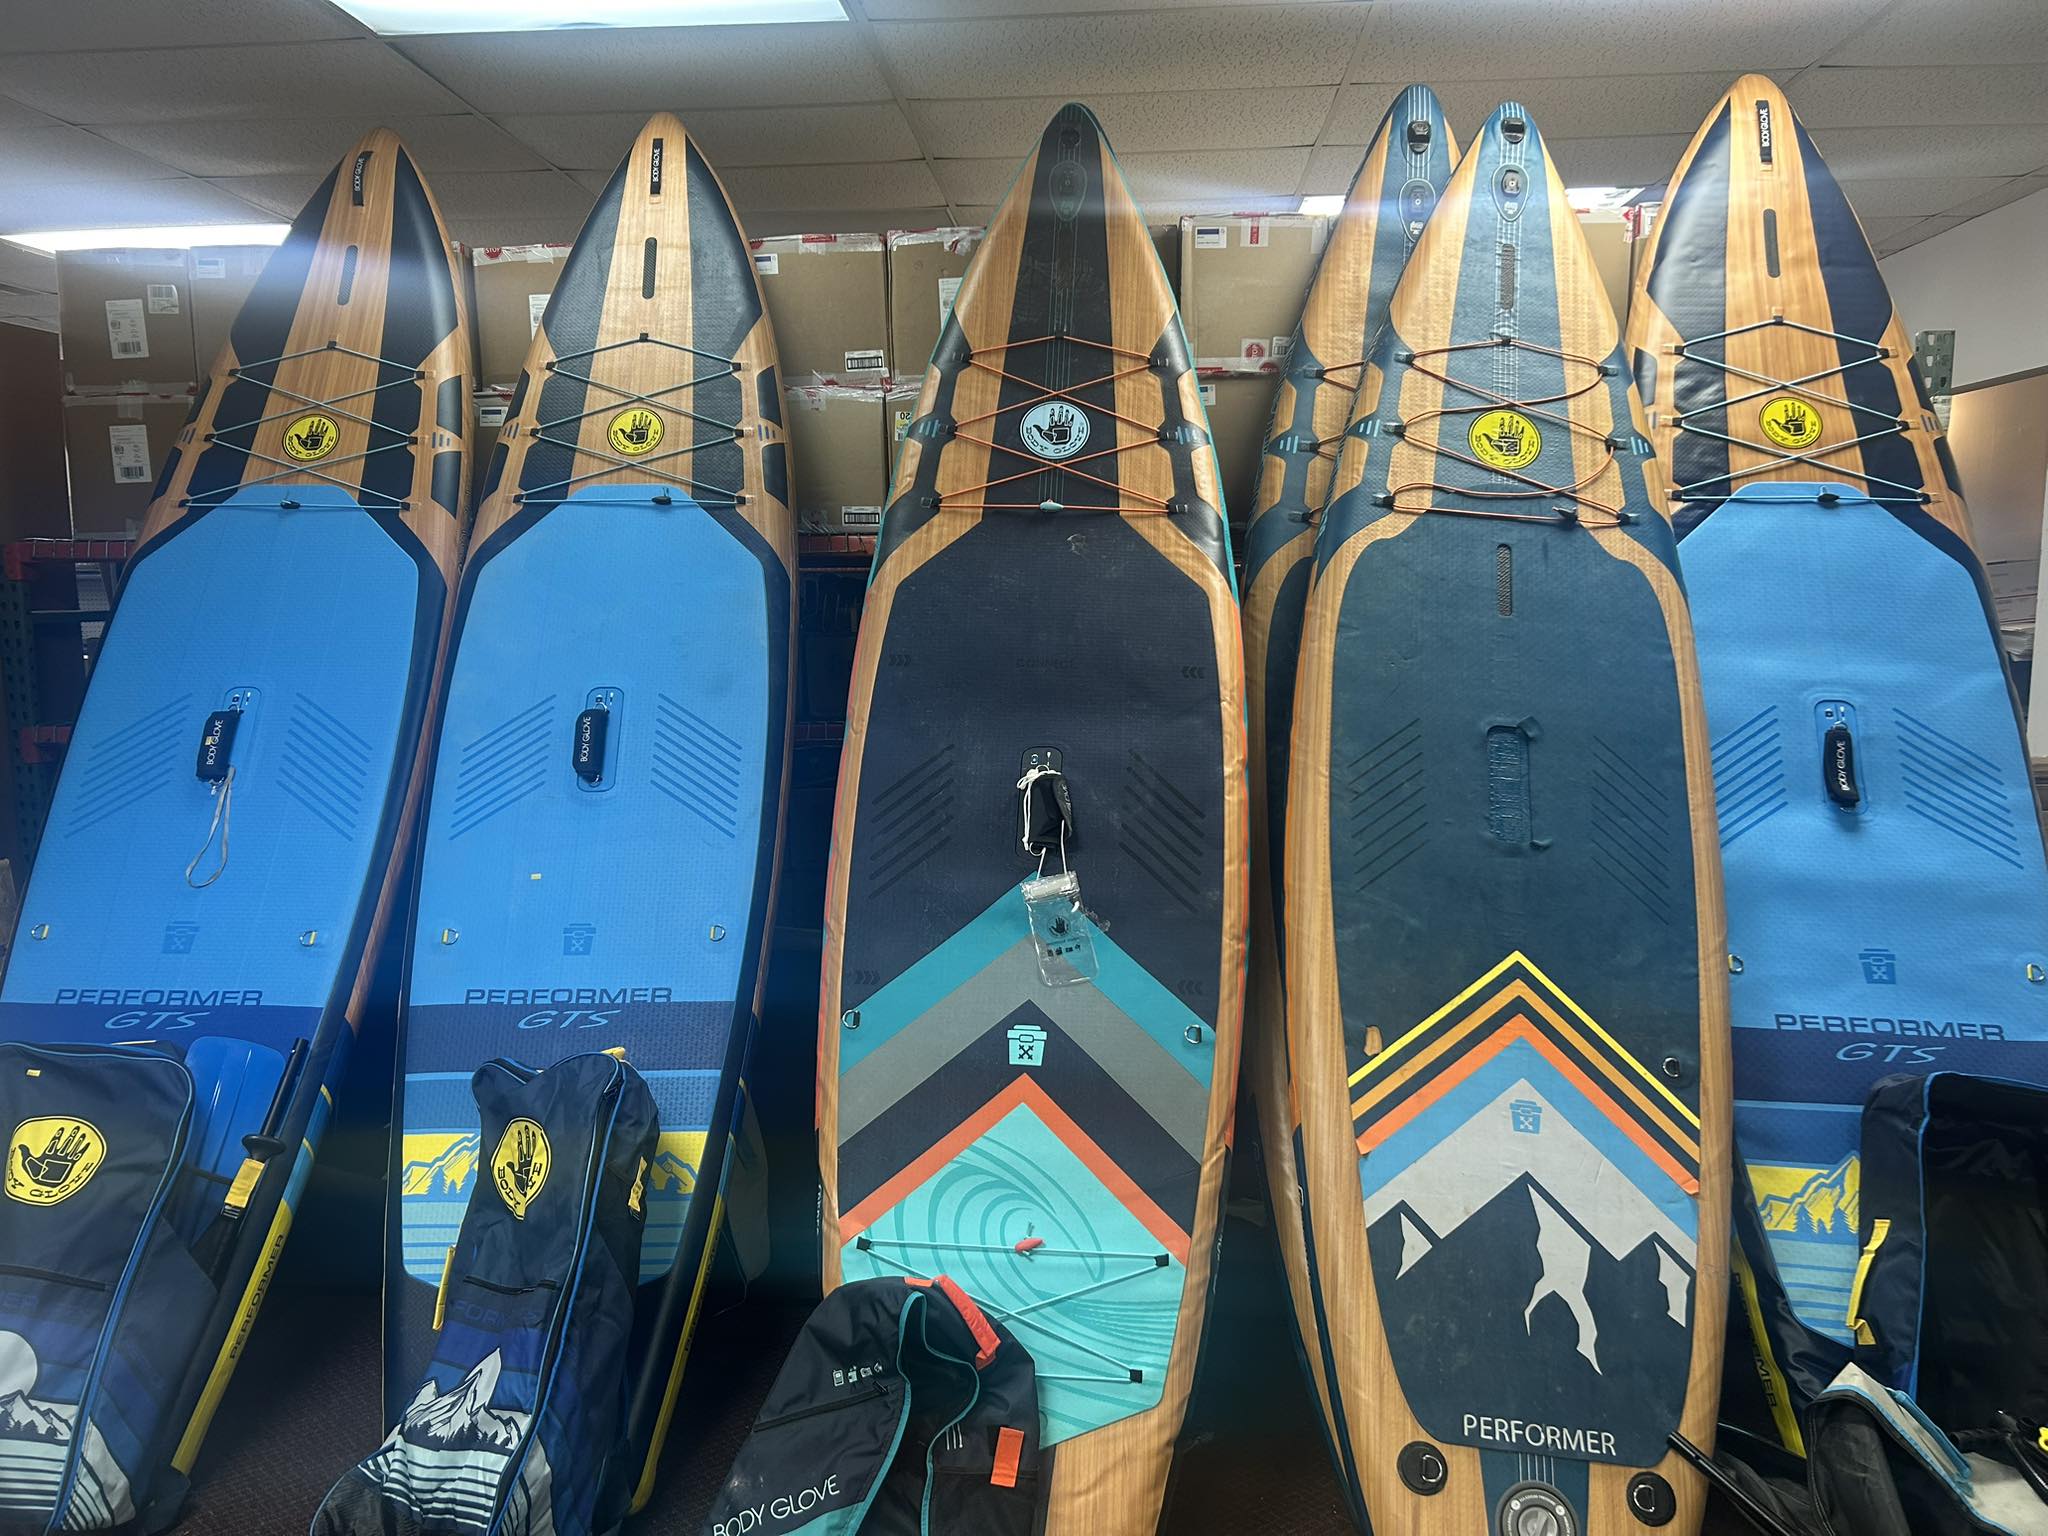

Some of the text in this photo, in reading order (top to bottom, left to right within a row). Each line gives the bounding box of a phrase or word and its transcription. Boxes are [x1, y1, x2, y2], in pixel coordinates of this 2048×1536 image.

[1760, 107, 1770, 147] BODY GLOVE
[1025, 426, 1085, 454] BODY GLOVE
[580, 716, 591, 762] BODY GLOVE
[206, 745, 217, 765] BODY
[54, 988, 264, 1007] PERFORMER
[463, 987, 673, 1005] PERFORMER
[104, 1011, 211, 1030] GTS
[517, 1009, 622, 1029] GTS
[1774, 1013, 2005, 1041] PERFORMER
[1835, 1042, 1947, 1064] GTS
[29, 1162, 94, 1198] GLOVE
[229, 1234, 284, 1359] PERFORMER
[1463, 1413, 1617, 1456] PERFORMER
[713, 1474, 840, 1536] BODY GLOVE
